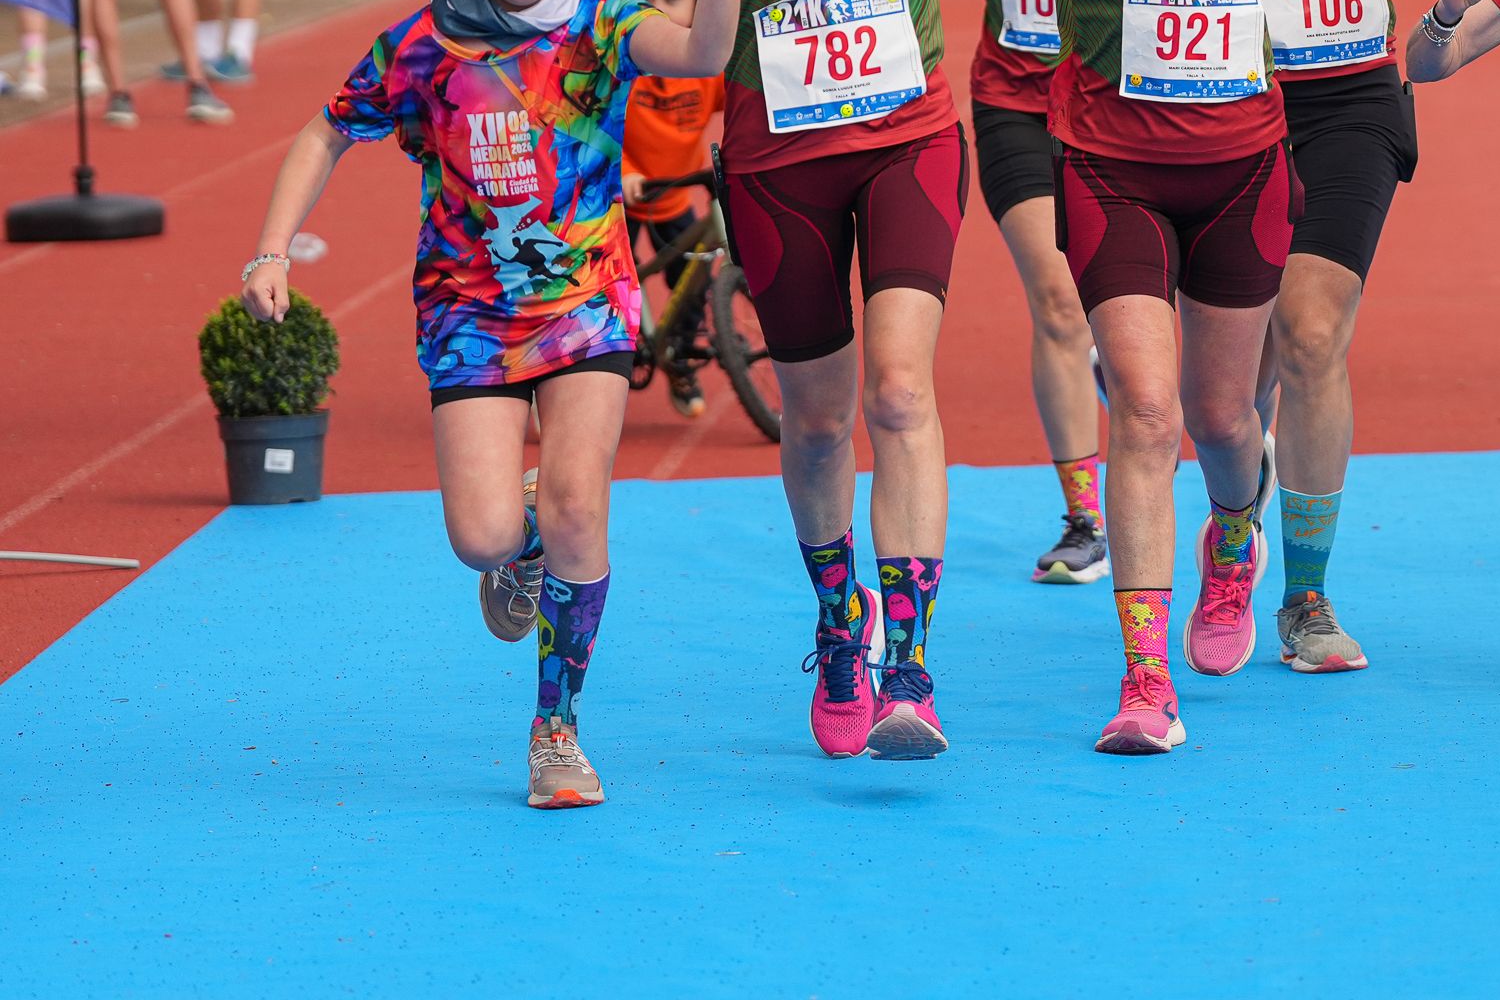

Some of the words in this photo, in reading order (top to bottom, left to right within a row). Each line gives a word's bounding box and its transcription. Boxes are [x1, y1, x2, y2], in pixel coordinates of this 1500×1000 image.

[1155, 11, 1231, 61] 921
[794, 25, 882, 86] 782
[466, 111, 508, 146] XII
[507, 109, 530, 132] 08
[469, 145, 512, 164] MEDIA
[511, 142, 533, 155] 2026
[472, 157, 537, 180] MARATÓN
[484, 179, 509, 197] 10K
